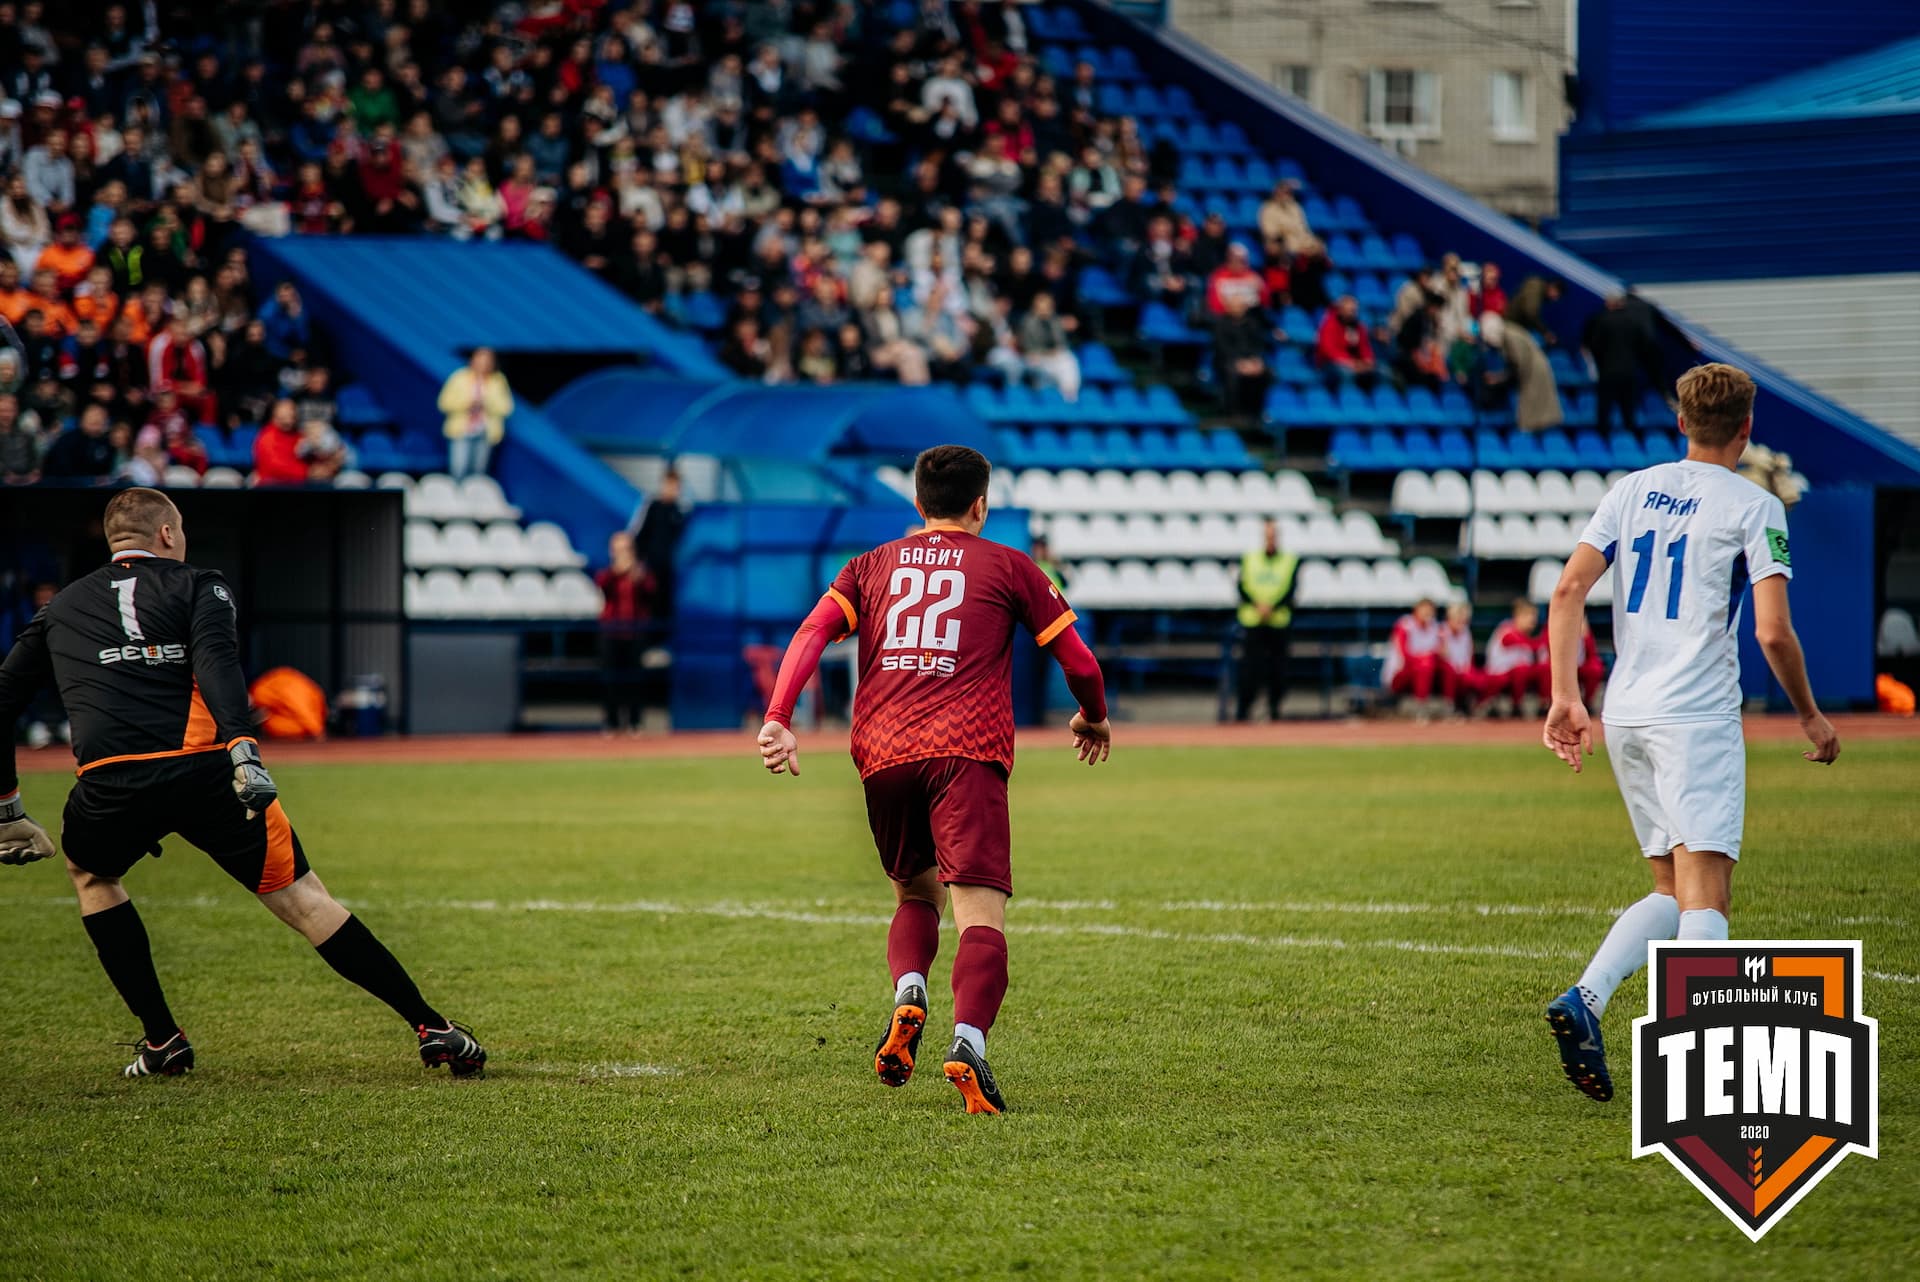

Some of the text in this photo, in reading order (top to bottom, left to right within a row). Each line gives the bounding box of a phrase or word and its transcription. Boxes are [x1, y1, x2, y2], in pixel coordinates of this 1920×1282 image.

[899, 547, 964, 566] БАБИЧ
[1626, 530, 1688, 619] 11
[111, 576, 145, 641] 1
[882, 568, 966, 652] 22
[98, 643, 184, 664] SEUS
[881, 652, 957, 673] SEUS
